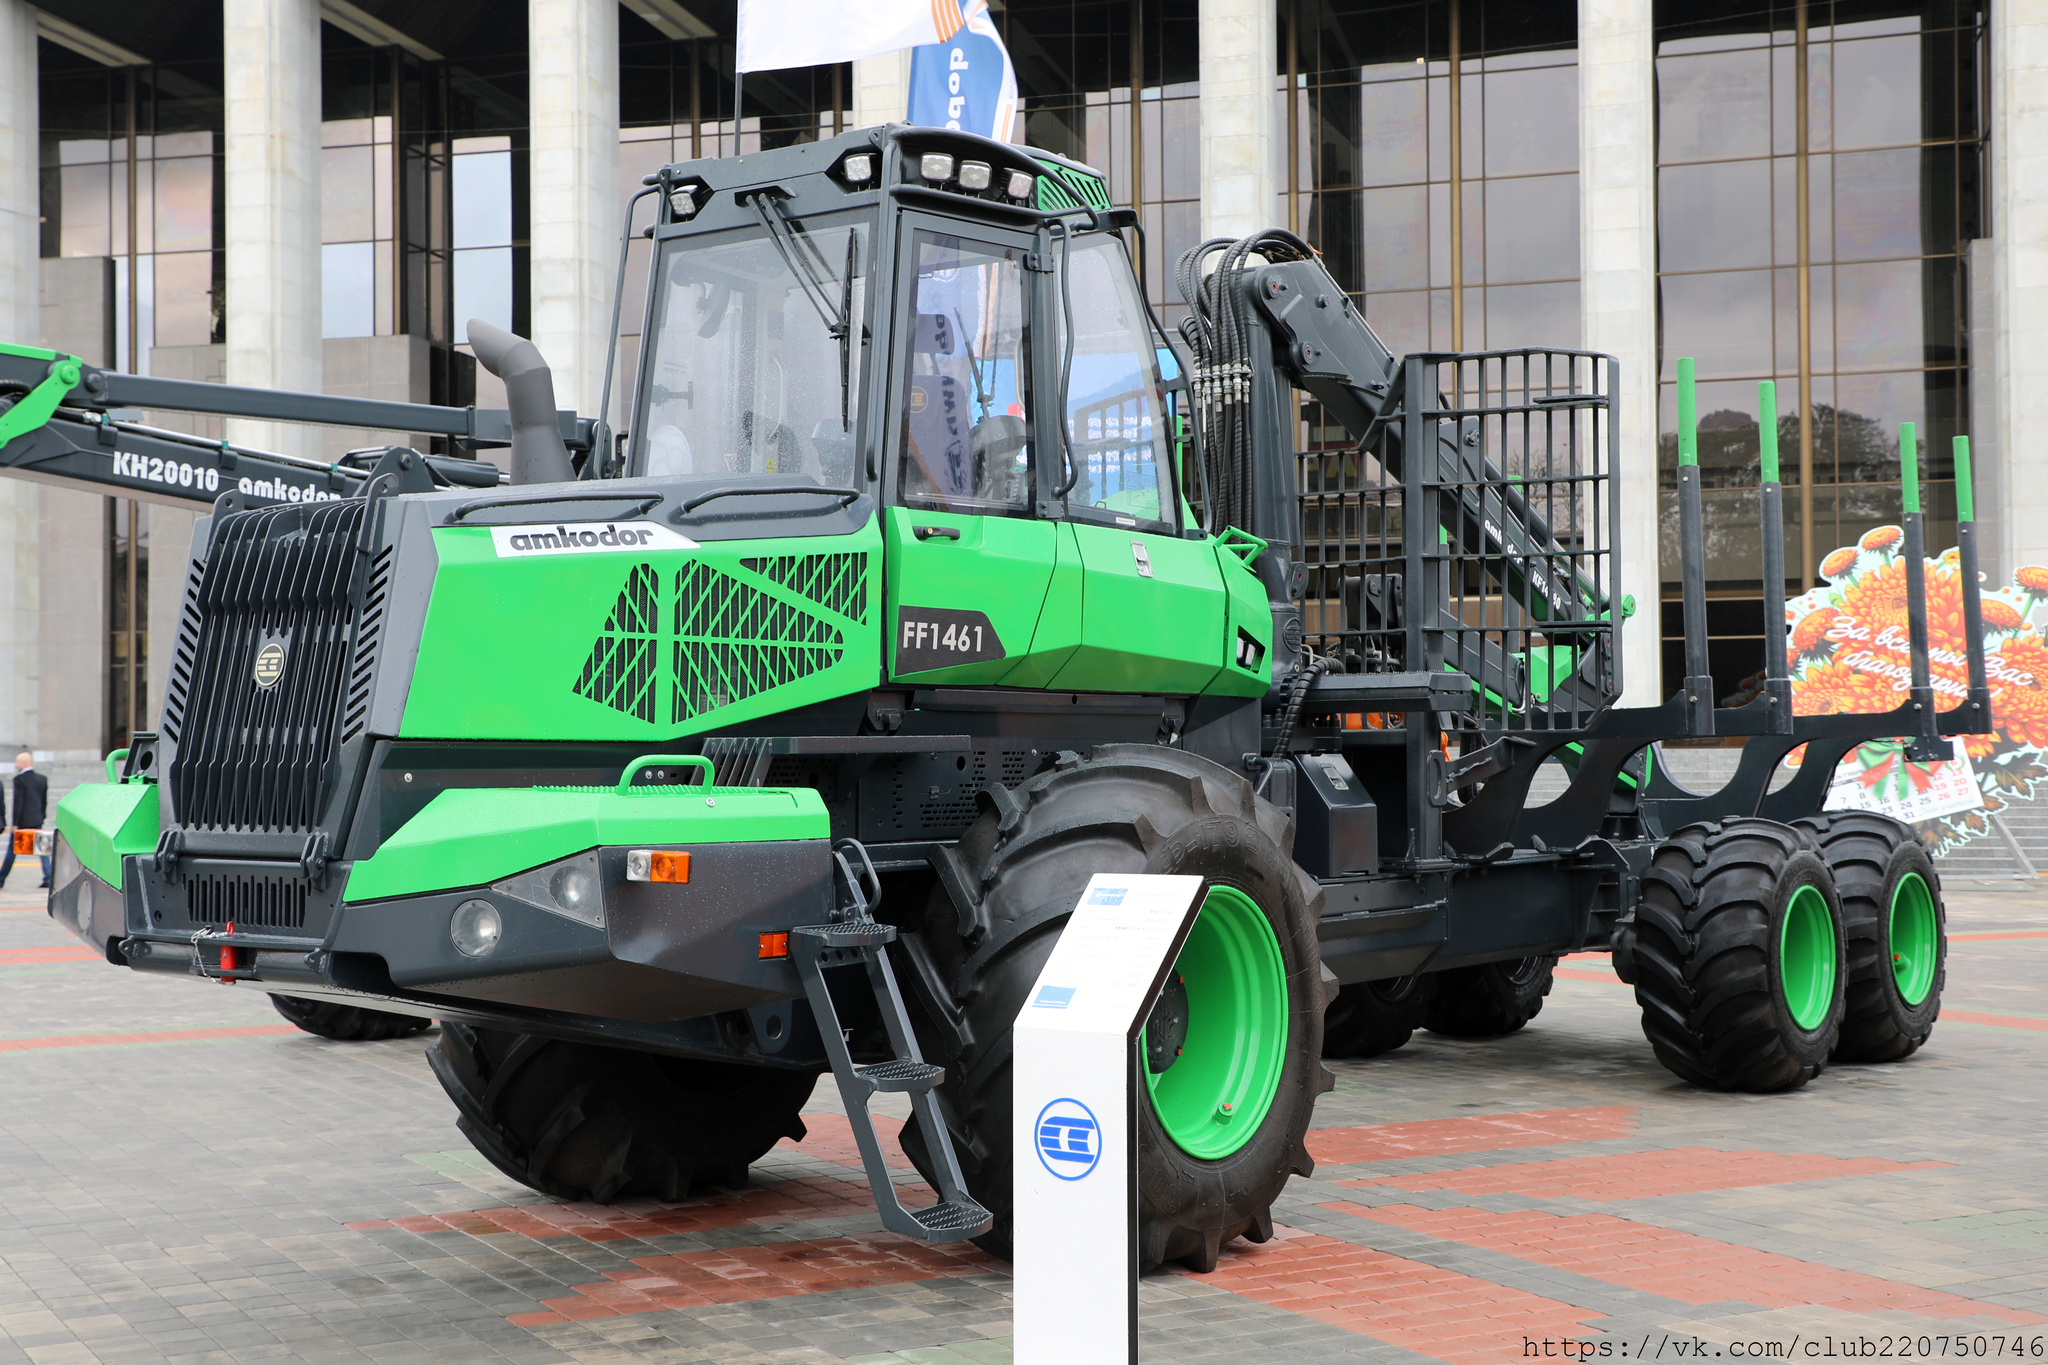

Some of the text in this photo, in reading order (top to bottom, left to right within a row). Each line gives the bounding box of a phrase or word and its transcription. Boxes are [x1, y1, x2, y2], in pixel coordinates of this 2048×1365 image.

[113, 450, 219, 492] KH20010
[510, 524, 654, 551] amkodor
[903, 621, 982, 652] FF1461
[1826, 616, 1871, 641] За
[1933, 772, 1943, 781] 12
[1860, 801, 1871, 809] 15
[1934, 782, 1947, 791] 19
[1953, 777, 1966, 786] 20
[1900, 801, 1912, 810] 24
[1919, 796, 1931, 805] 25
[1938, 792, 1951, 800] 26
[1957, 787, 1969, 796] 27
